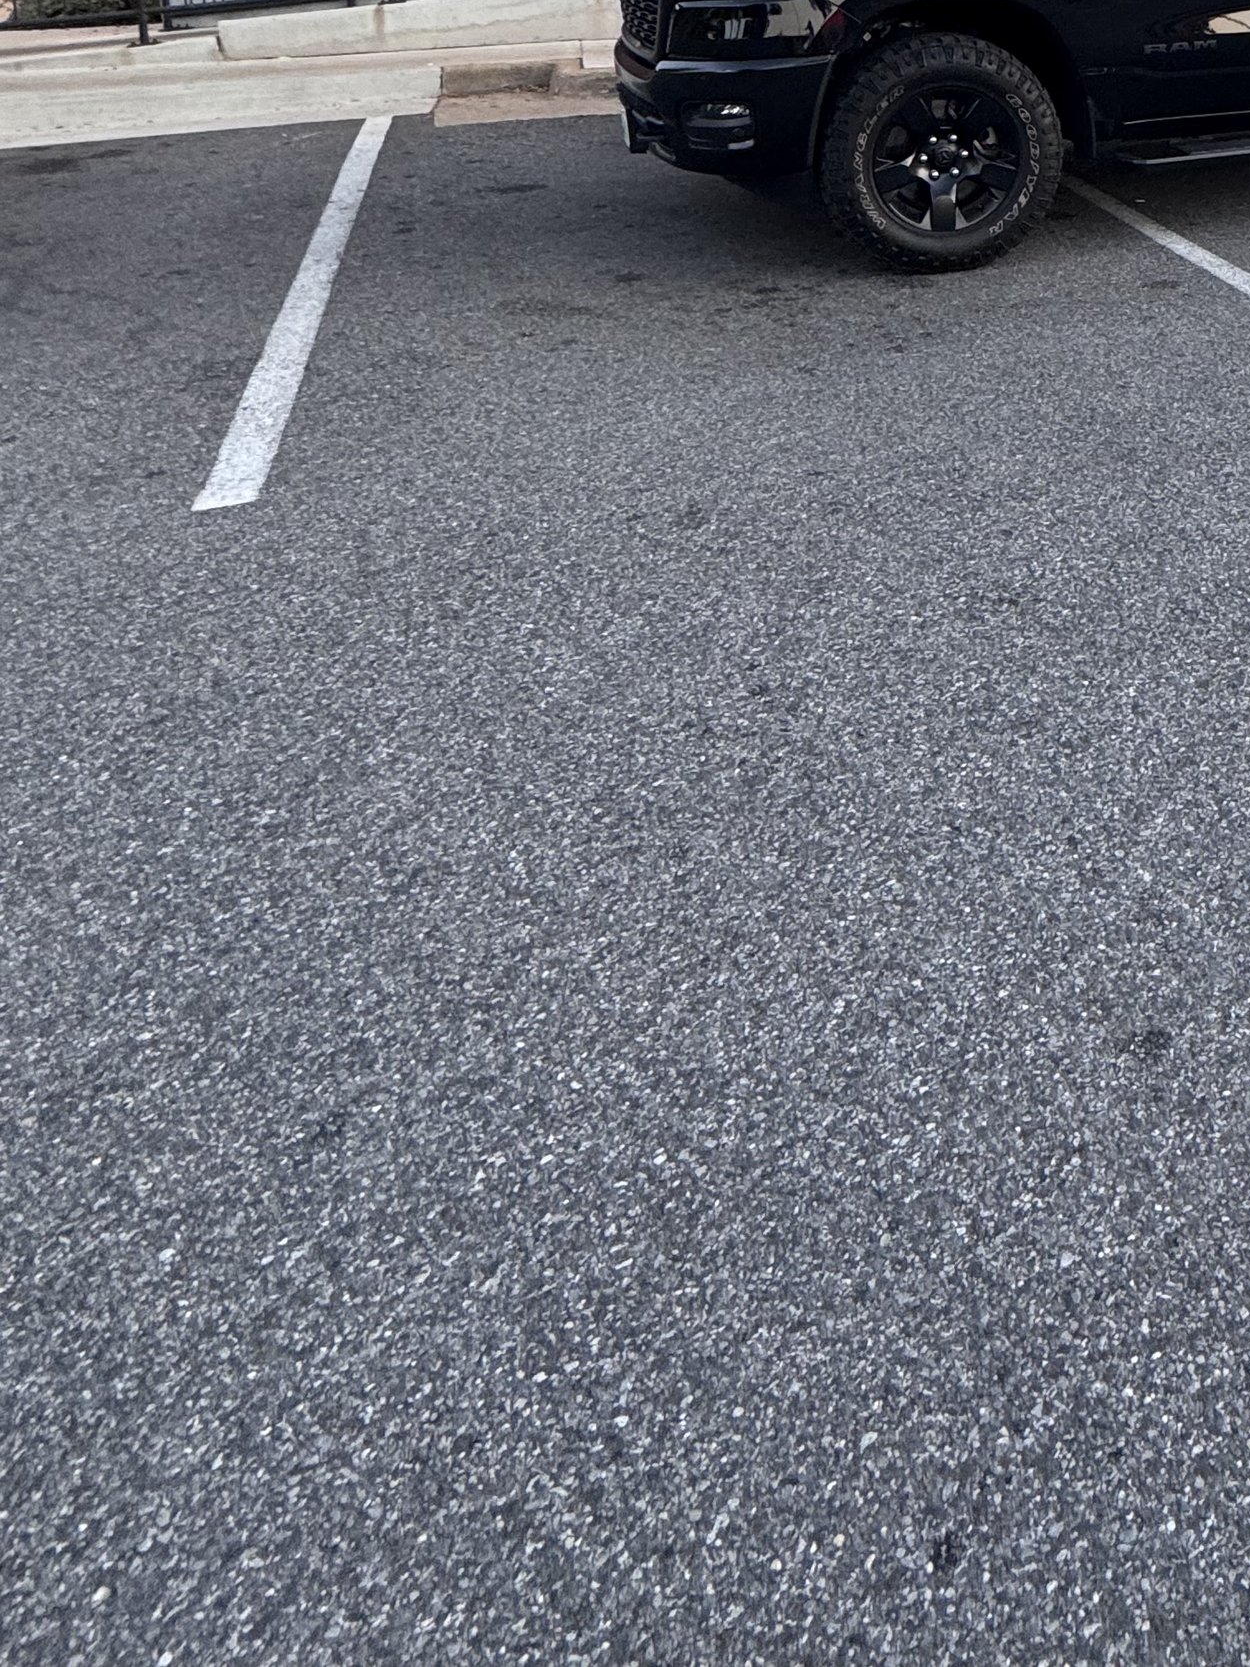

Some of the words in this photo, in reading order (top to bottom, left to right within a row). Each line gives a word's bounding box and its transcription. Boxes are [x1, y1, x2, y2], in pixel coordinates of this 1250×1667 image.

[1143, 39, 1218, 55] RAM
[853, 85, 905, 231] WRANGLER
[988, 92, 1041, 238] GOODYEAR
